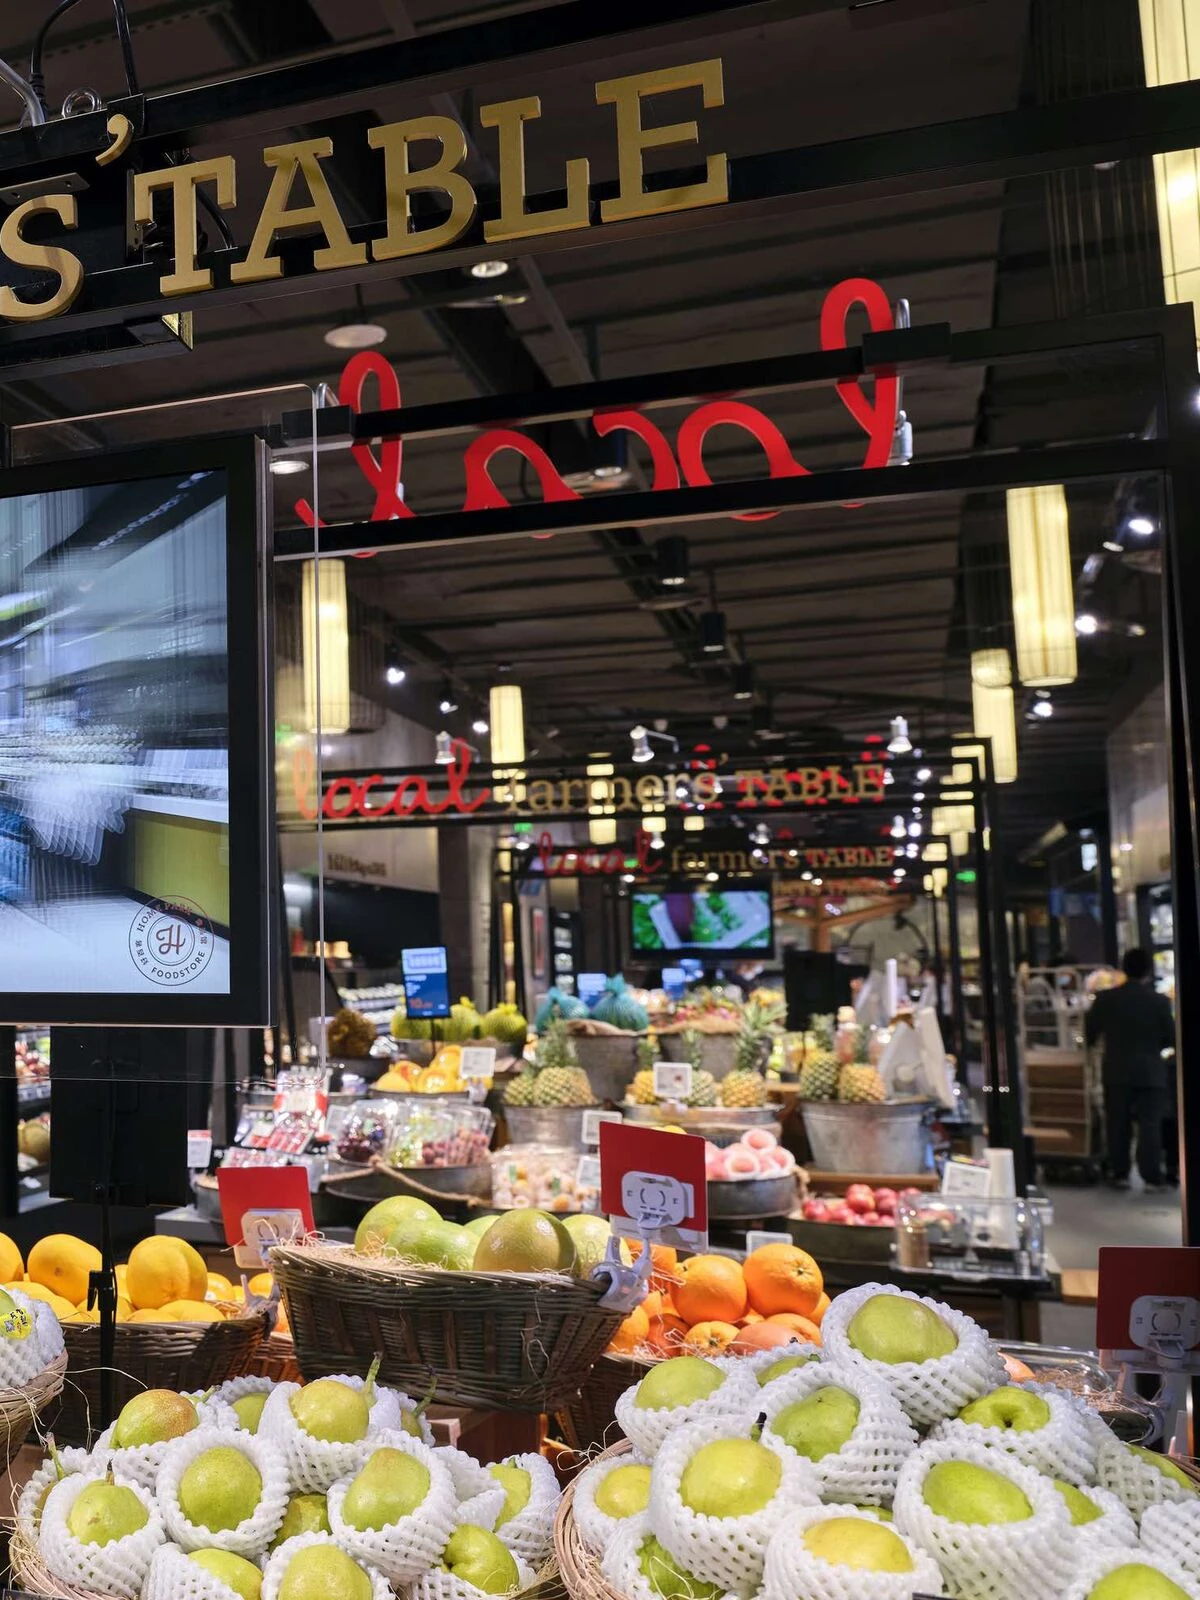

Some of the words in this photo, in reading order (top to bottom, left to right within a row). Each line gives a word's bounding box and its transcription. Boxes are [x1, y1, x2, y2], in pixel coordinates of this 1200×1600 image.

[133, 58, 729, 296] TABLE
[293, 737, 491, 820] local
[735, 763, 886, 801] TABLE
[151, 951, 206, 979] FOODSTORE
